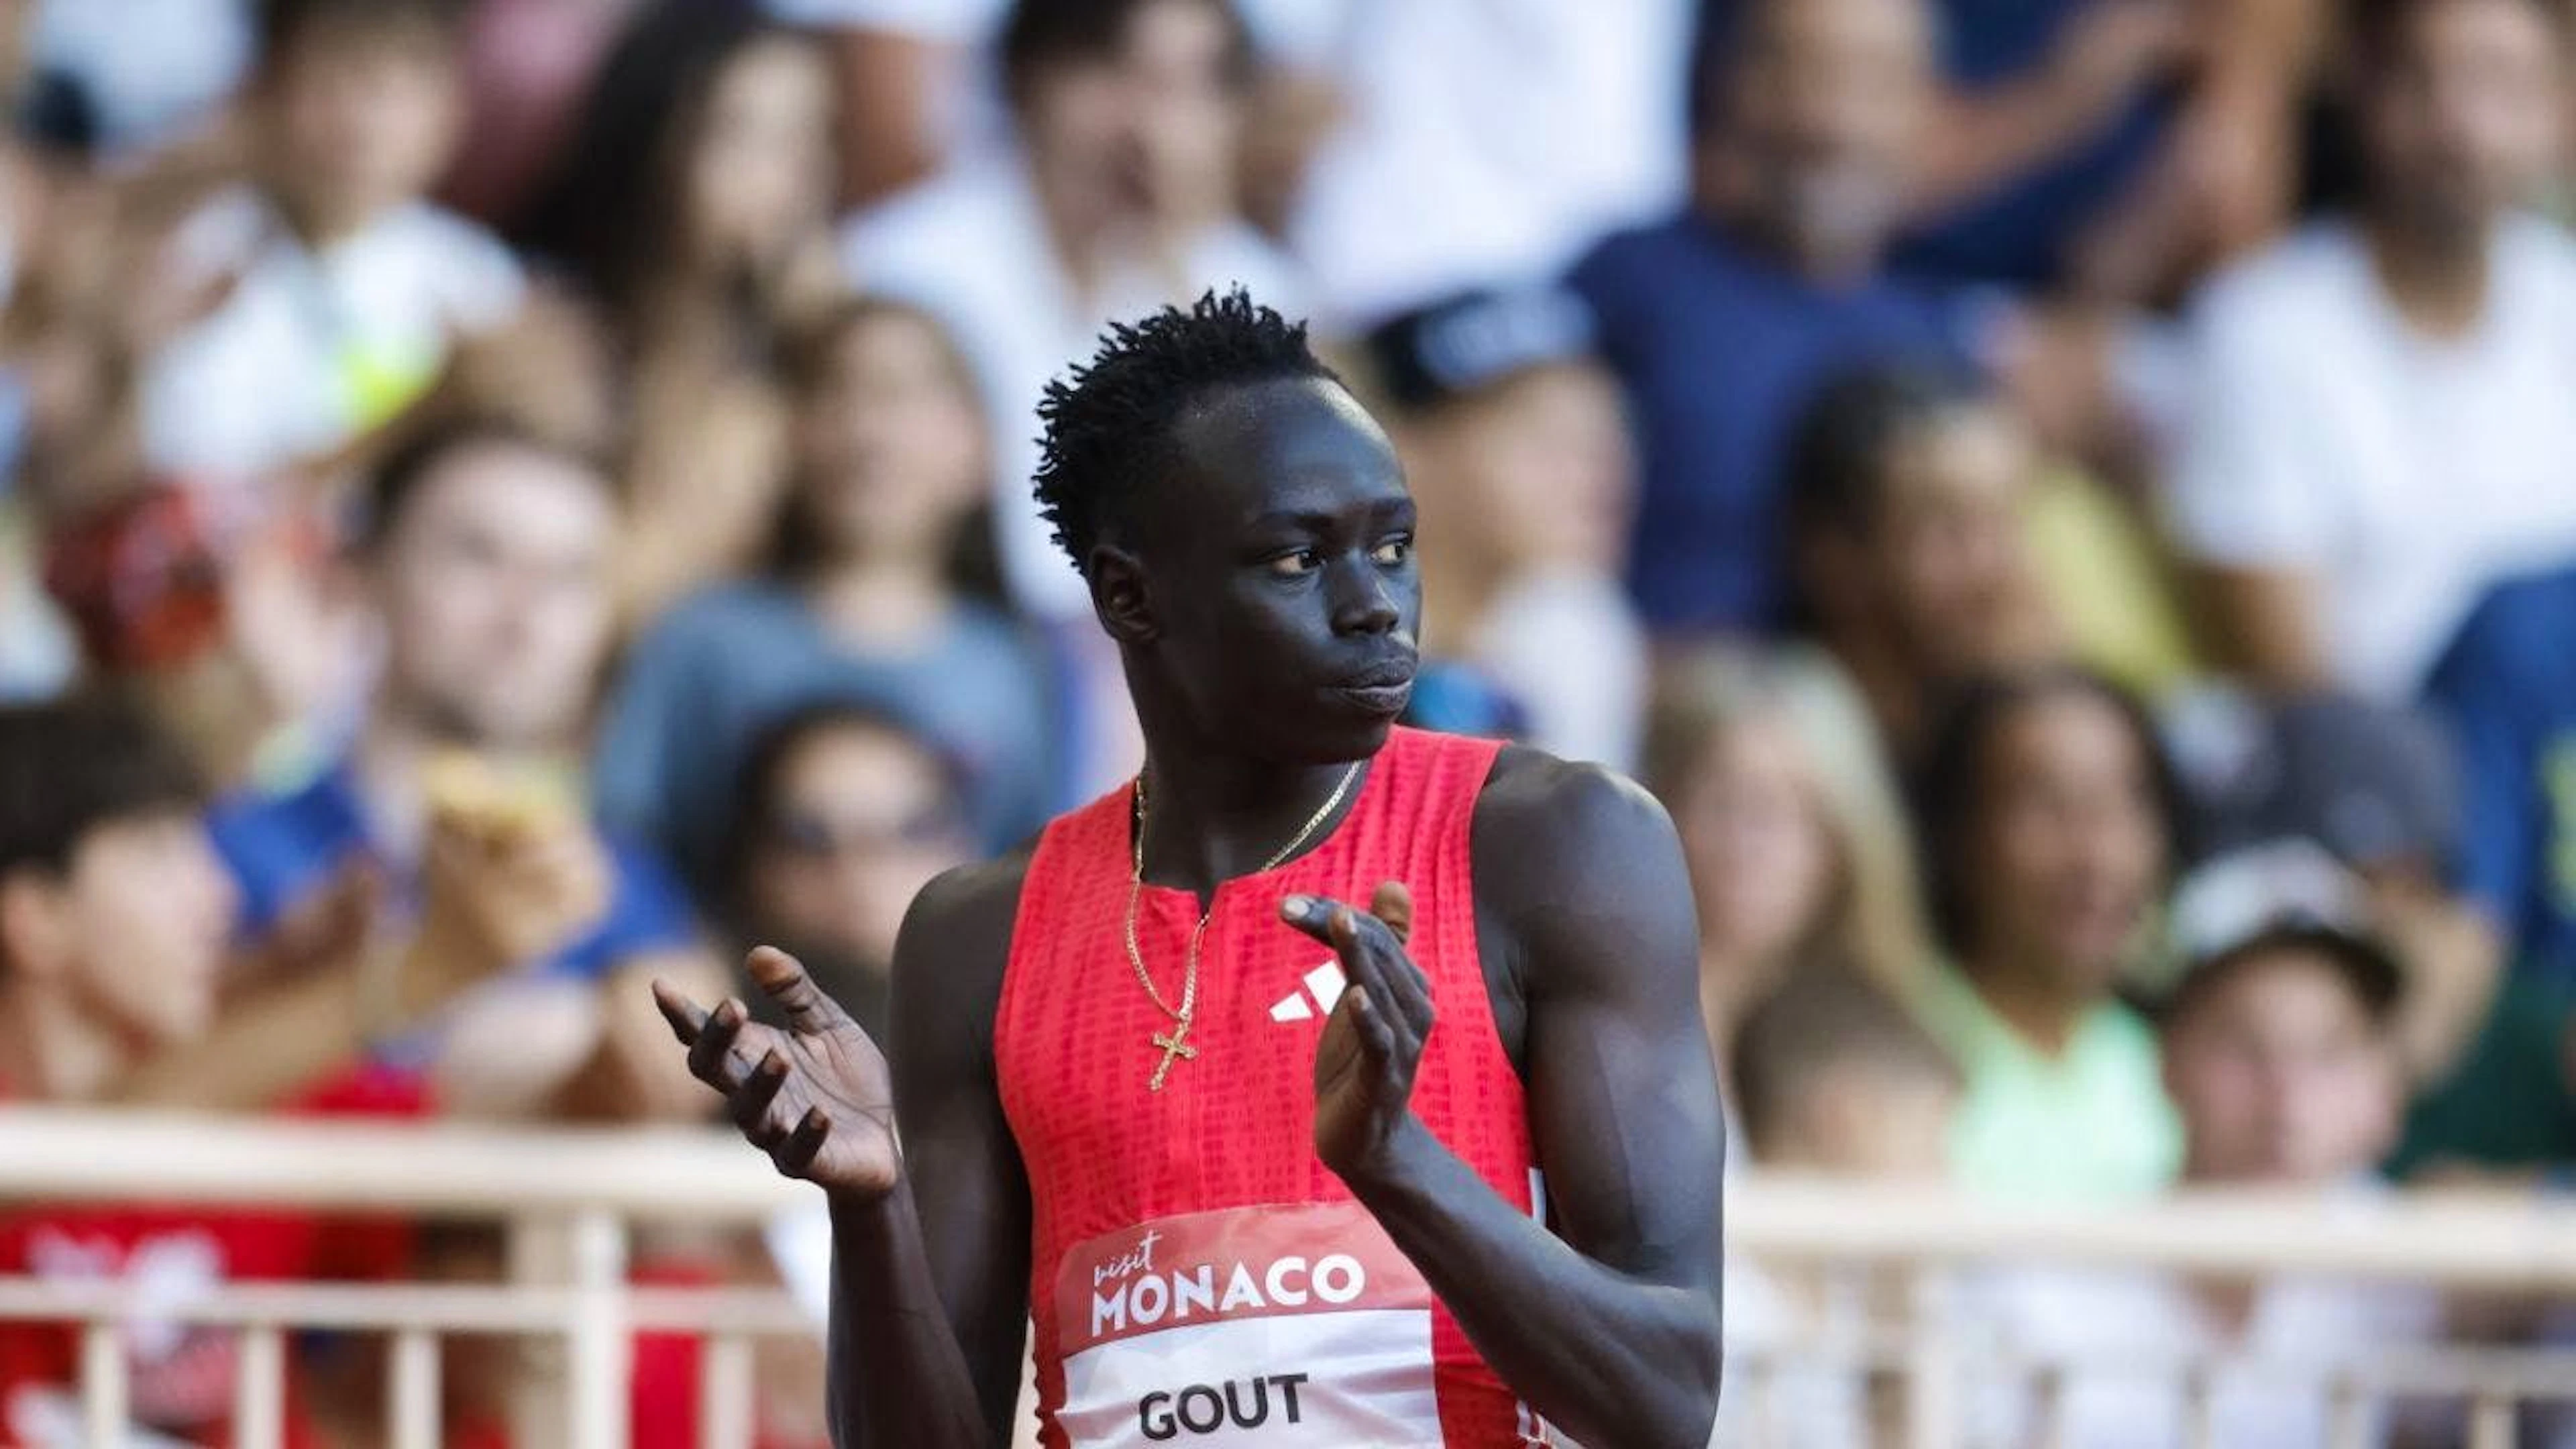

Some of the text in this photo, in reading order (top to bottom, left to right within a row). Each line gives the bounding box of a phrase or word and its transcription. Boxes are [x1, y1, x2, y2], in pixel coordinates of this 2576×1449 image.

[1094, 1230, 1162, 1287] visit
[1092, 1254, 1366, 1337] MONACO
[1140, 1373, 1309, 1441] GOUT
